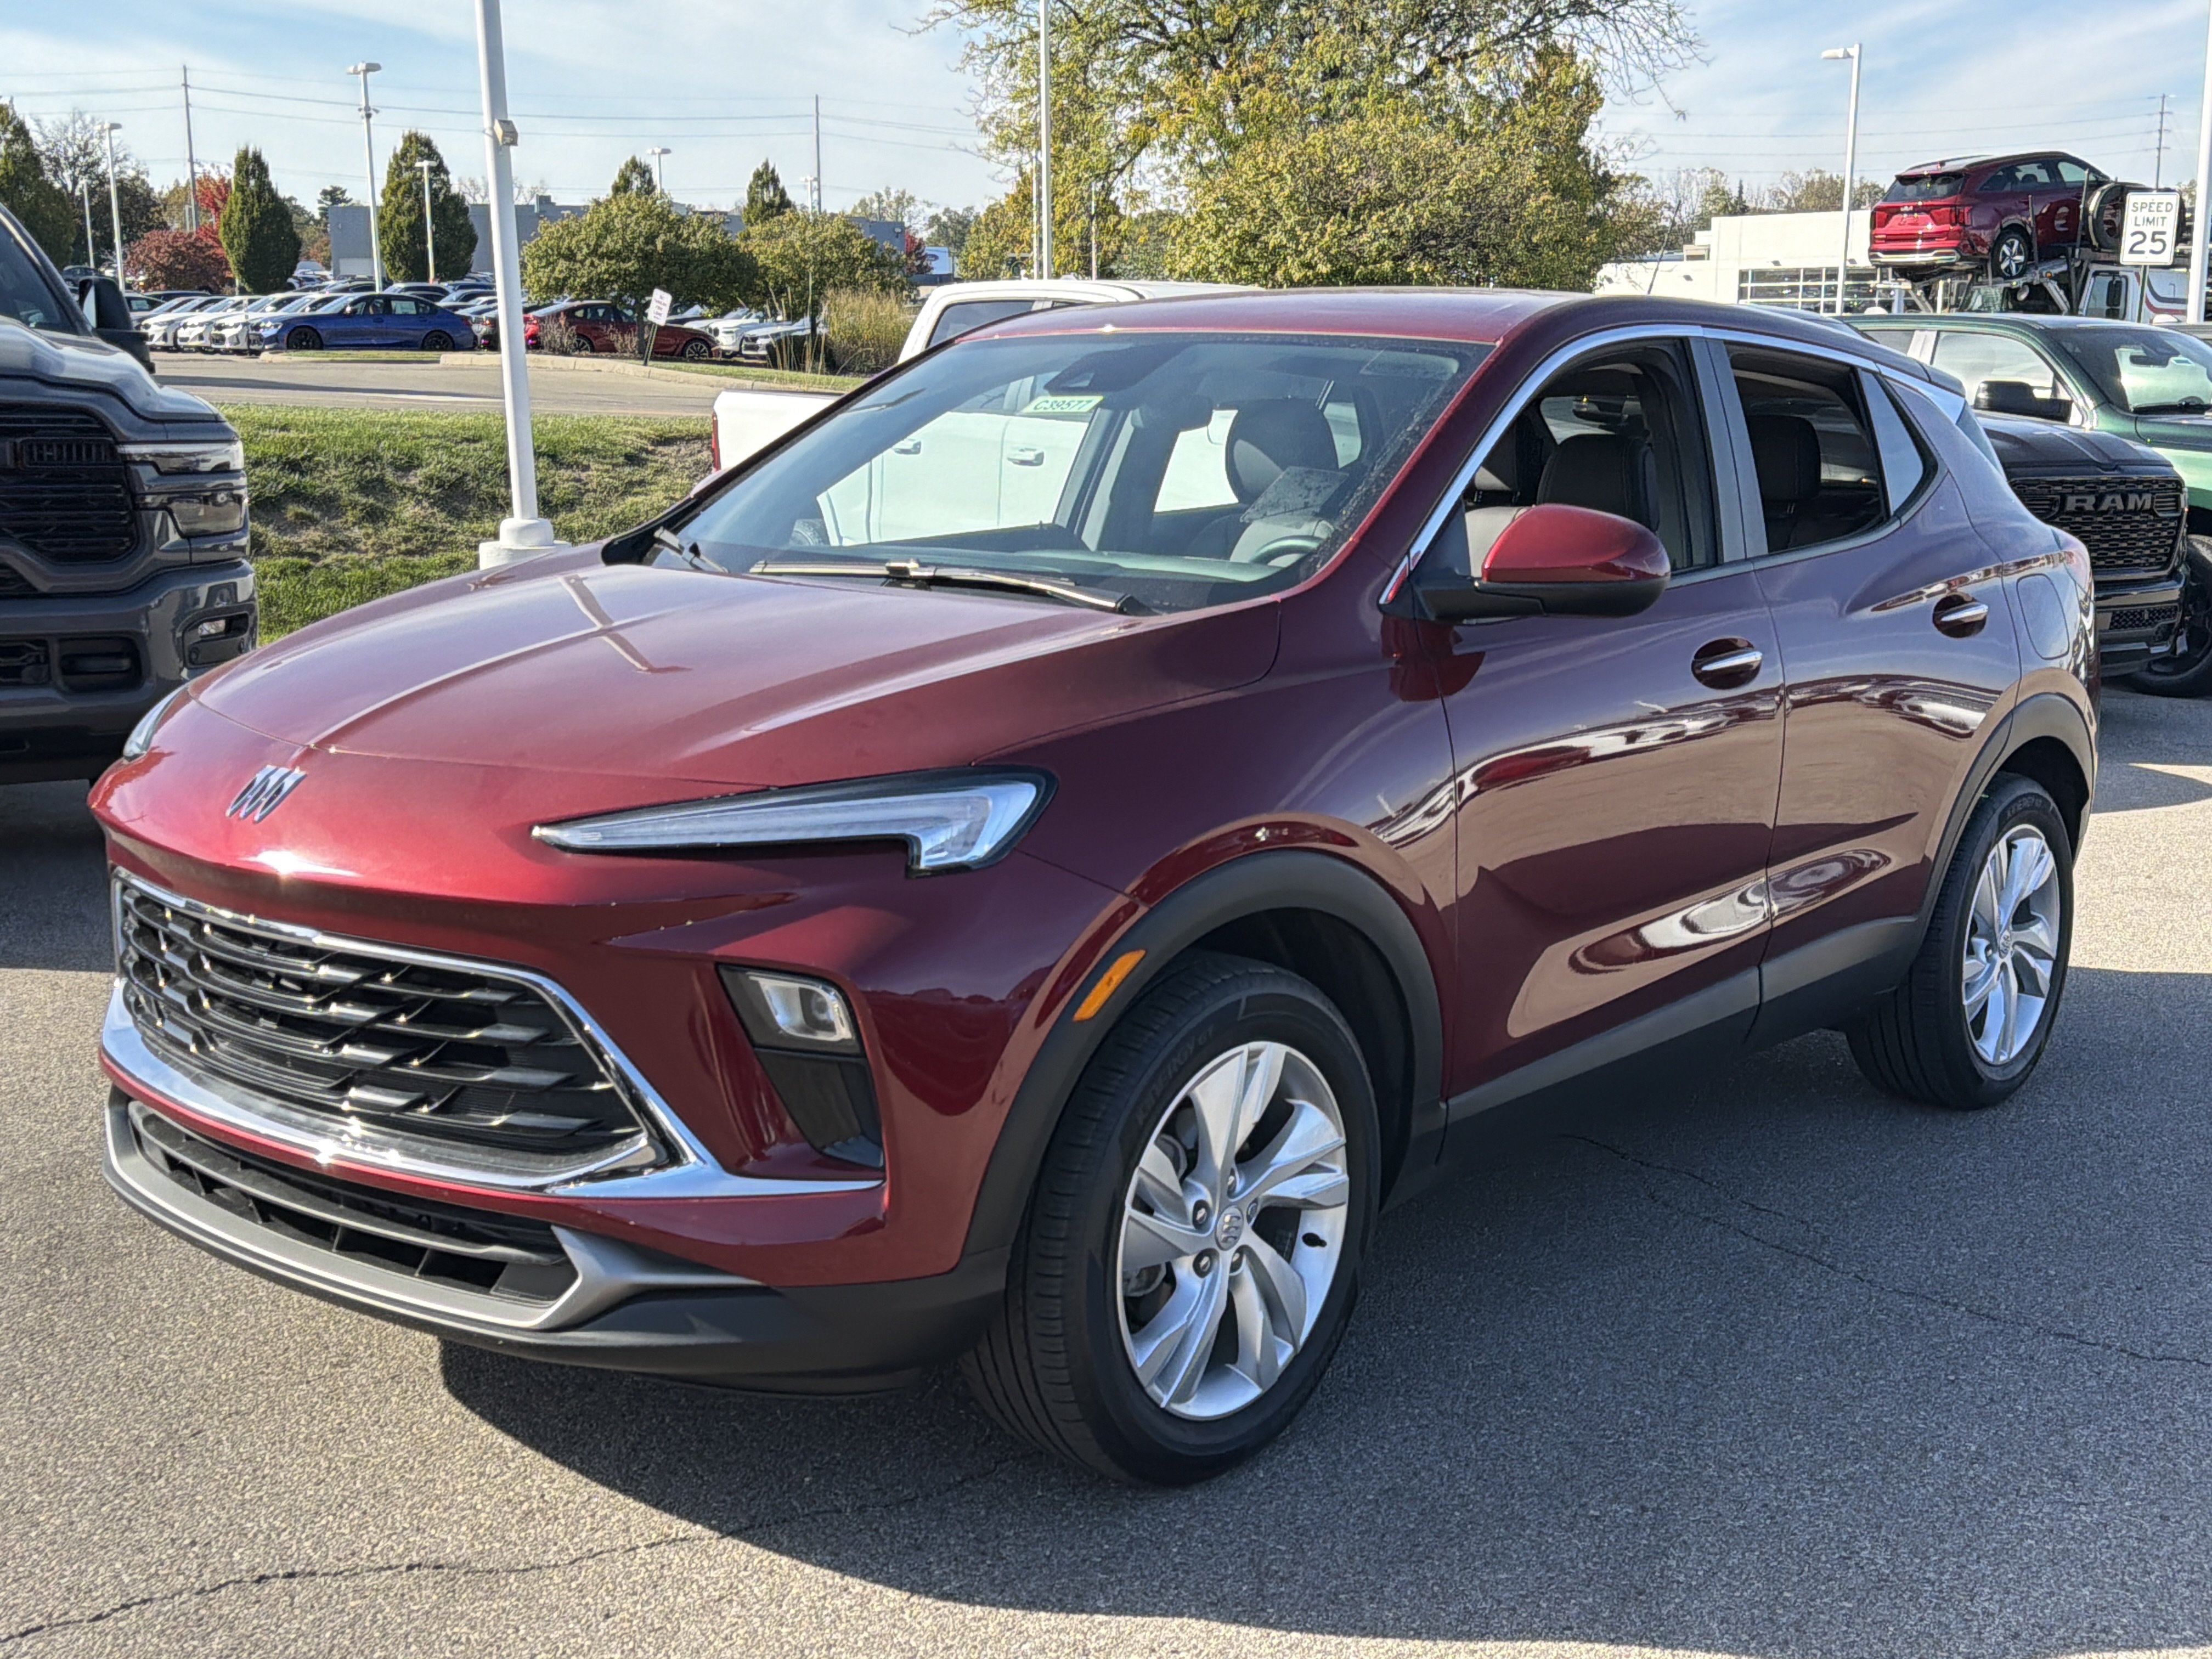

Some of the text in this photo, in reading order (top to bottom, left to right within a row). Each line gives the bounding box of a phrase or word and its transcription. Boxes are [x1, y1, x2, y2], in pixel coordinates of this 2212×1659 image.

[2131, 202, 2174, 213] SPEED
[2134, 216, 2168, 227] LIMIT
[2128, 231, 2168, 255] 25
[2066, 494, 2152, 511] RAM
